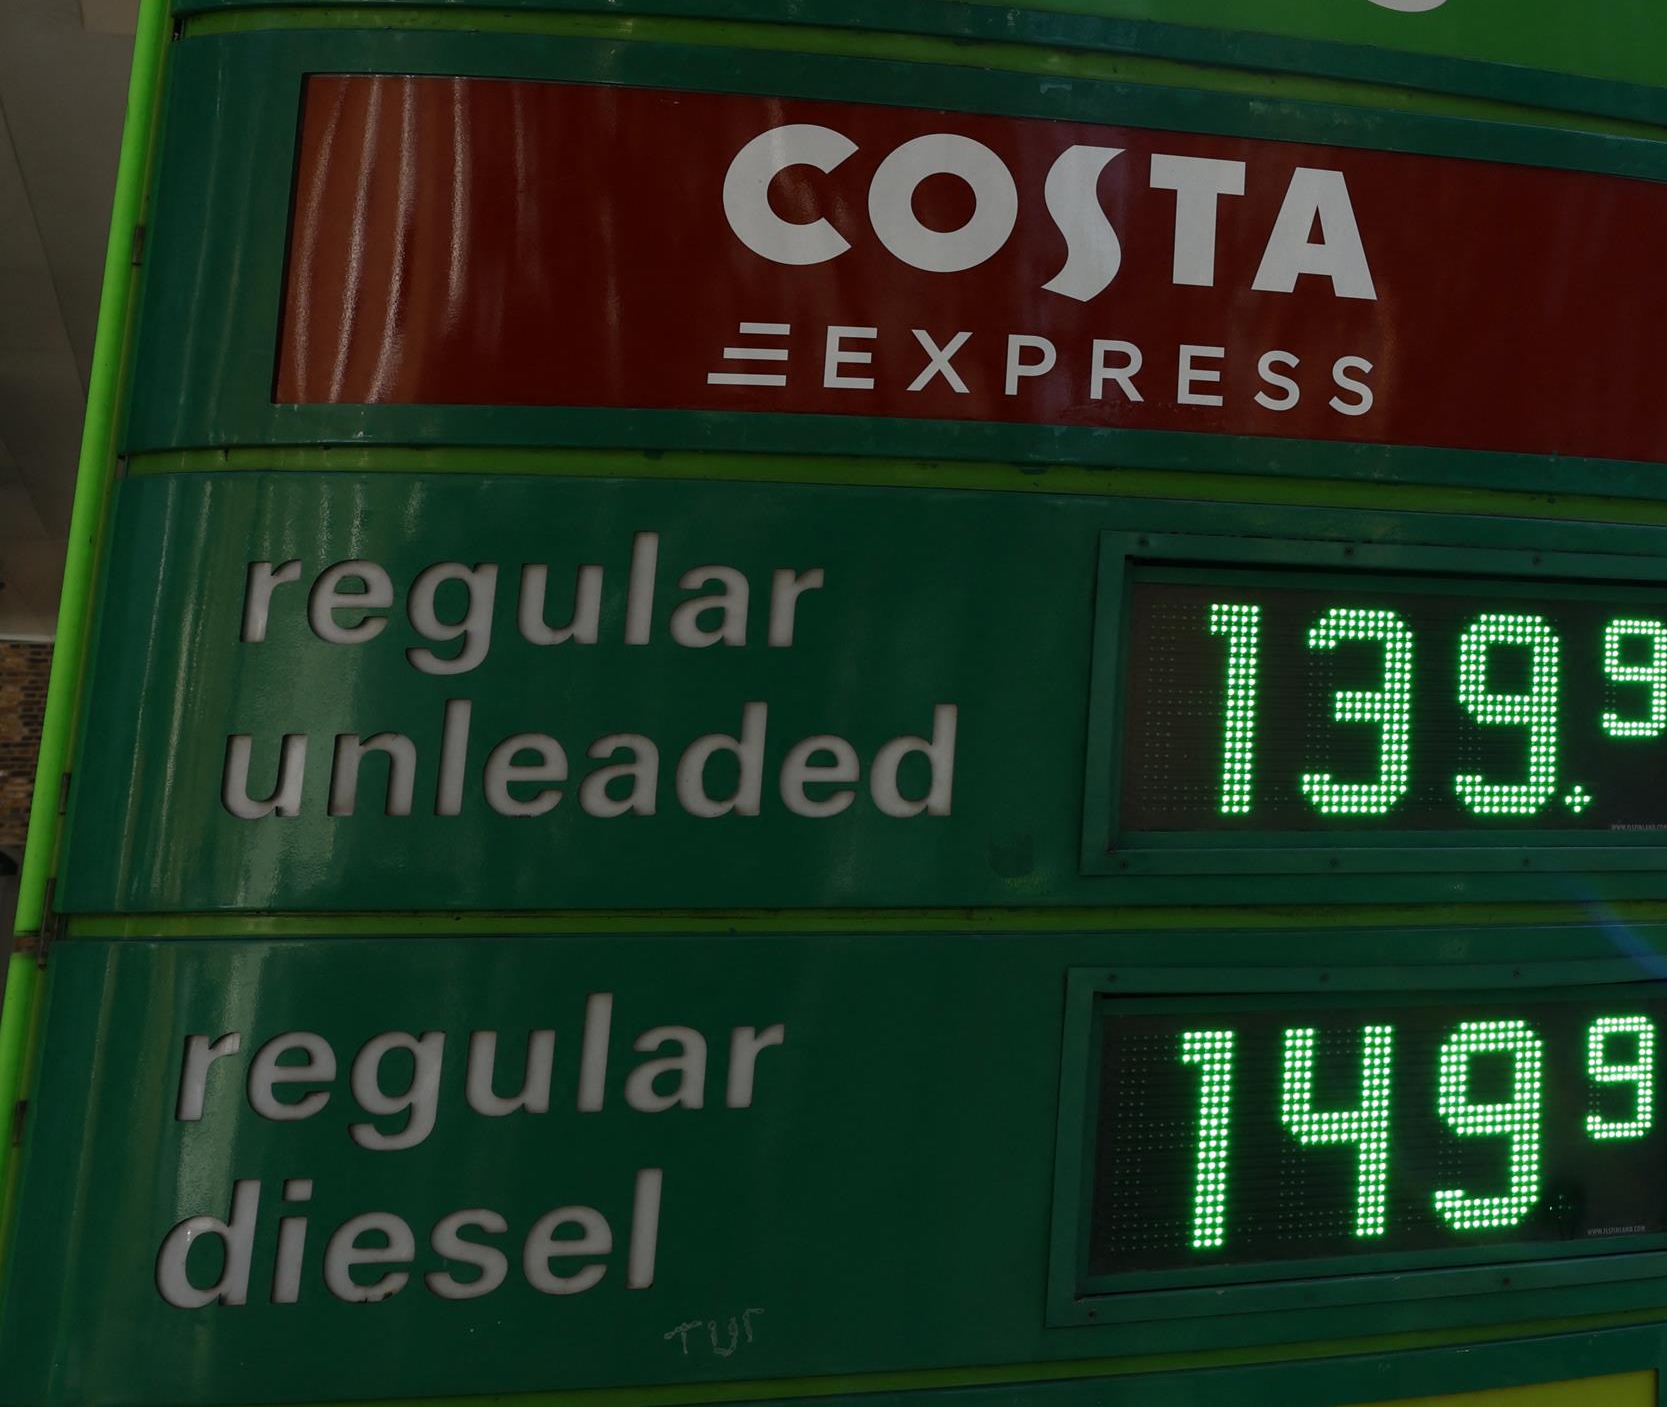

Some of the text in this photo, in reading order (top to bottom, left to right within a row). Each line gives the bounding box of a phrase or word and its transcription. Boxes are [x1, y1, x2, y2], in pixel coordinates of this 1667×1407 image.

[722, 124, 1378, 303] COSTA
[823, 325, 1375, 416] EXPRESS
[243, 532, 824, 675] regular
[222, 700, 959, 820] unleaded
[178, 993, 786, 1150] regular
[157, 1168, 661, 1307] diesel
